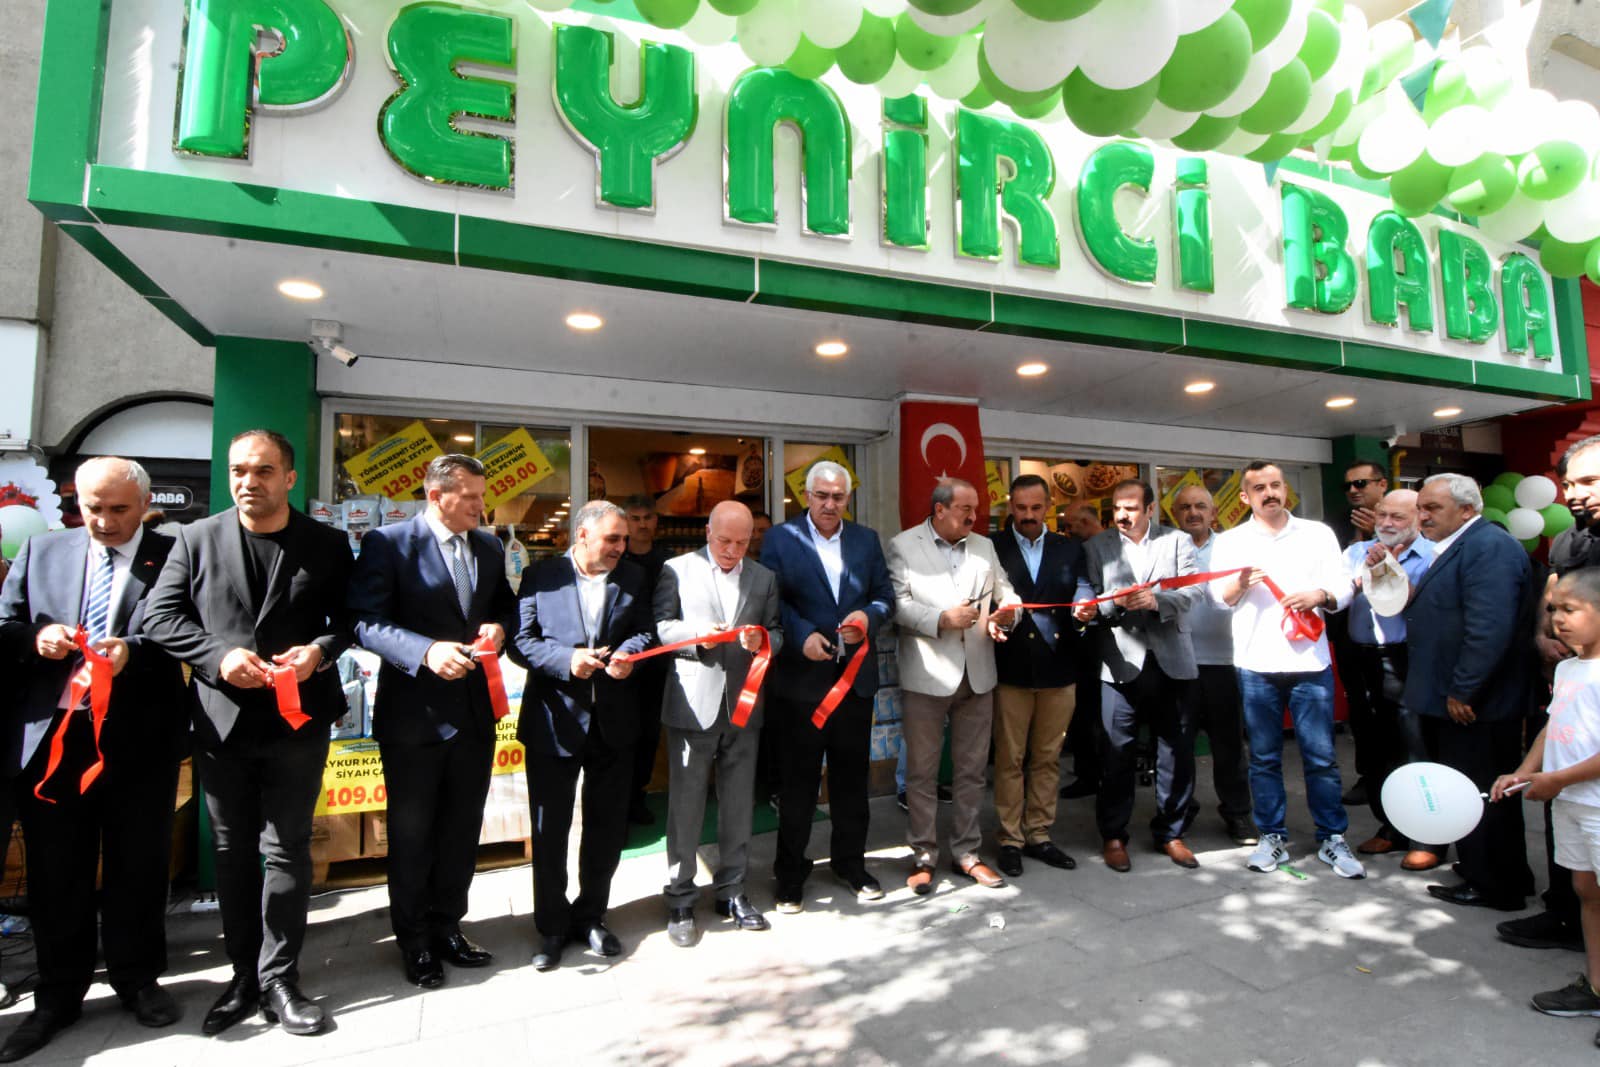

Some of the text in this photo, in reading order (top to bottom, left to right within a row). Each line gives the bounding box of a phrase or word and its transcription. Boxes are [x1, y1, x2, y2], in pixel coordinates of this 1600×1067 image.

[1280, 180, 1554, 362] BABA
[364, 469, 389, 486] JUMBO
[490, 461, 537, 496] 139.00
[325, 758, 360, 768] YKUR
[336, 769, 370, 779] SİYAH
